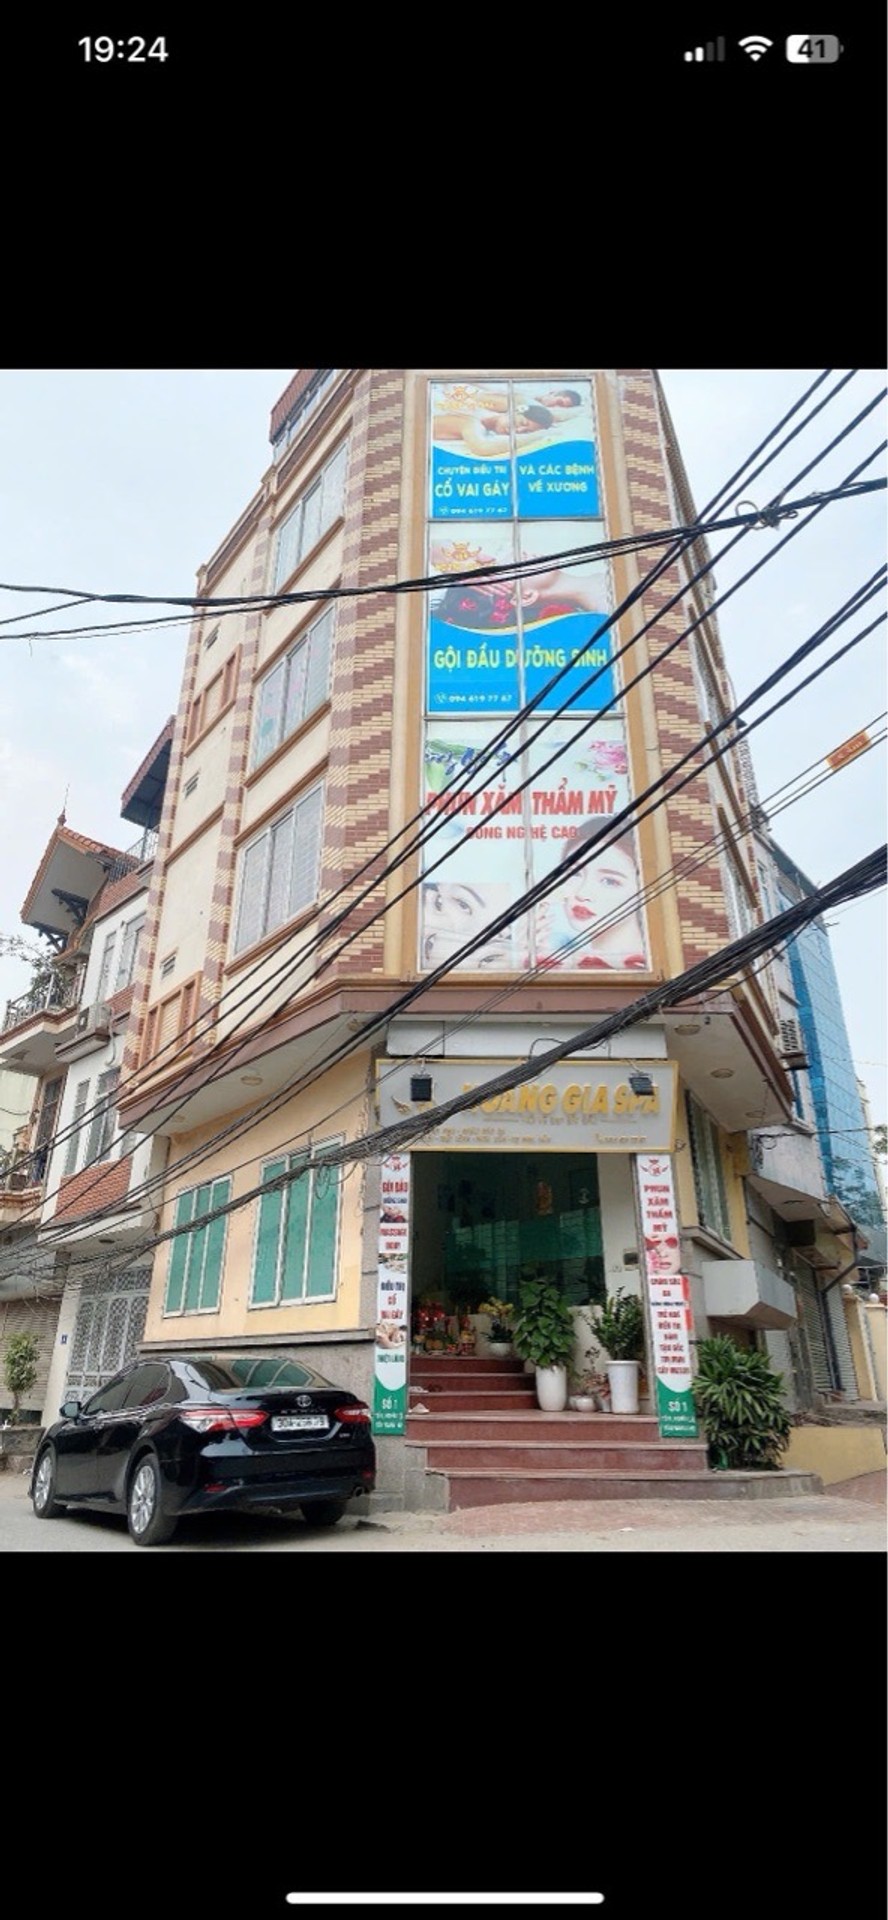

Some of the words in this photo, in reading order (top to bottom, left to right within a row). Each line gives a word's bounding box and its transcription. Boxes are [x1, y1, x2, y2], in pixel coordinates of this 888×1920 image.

[435, 476, 453, 498] CỔ
[457, 482, 479, 497] VAI
[483, 478, 510, 497] GÁY
[433, 644, 461, 674] GỘI
[571, 648, 608, 669] SINH
[449, 694, 466, 703] 094
[469, 694, 485, 702] 619
[488, 694, 498, 702] 77
[532, 776, 584, 815] THẨM
[588, 784, 618, 815] MỸ
[562, 1083, 609, 1115] GIA
